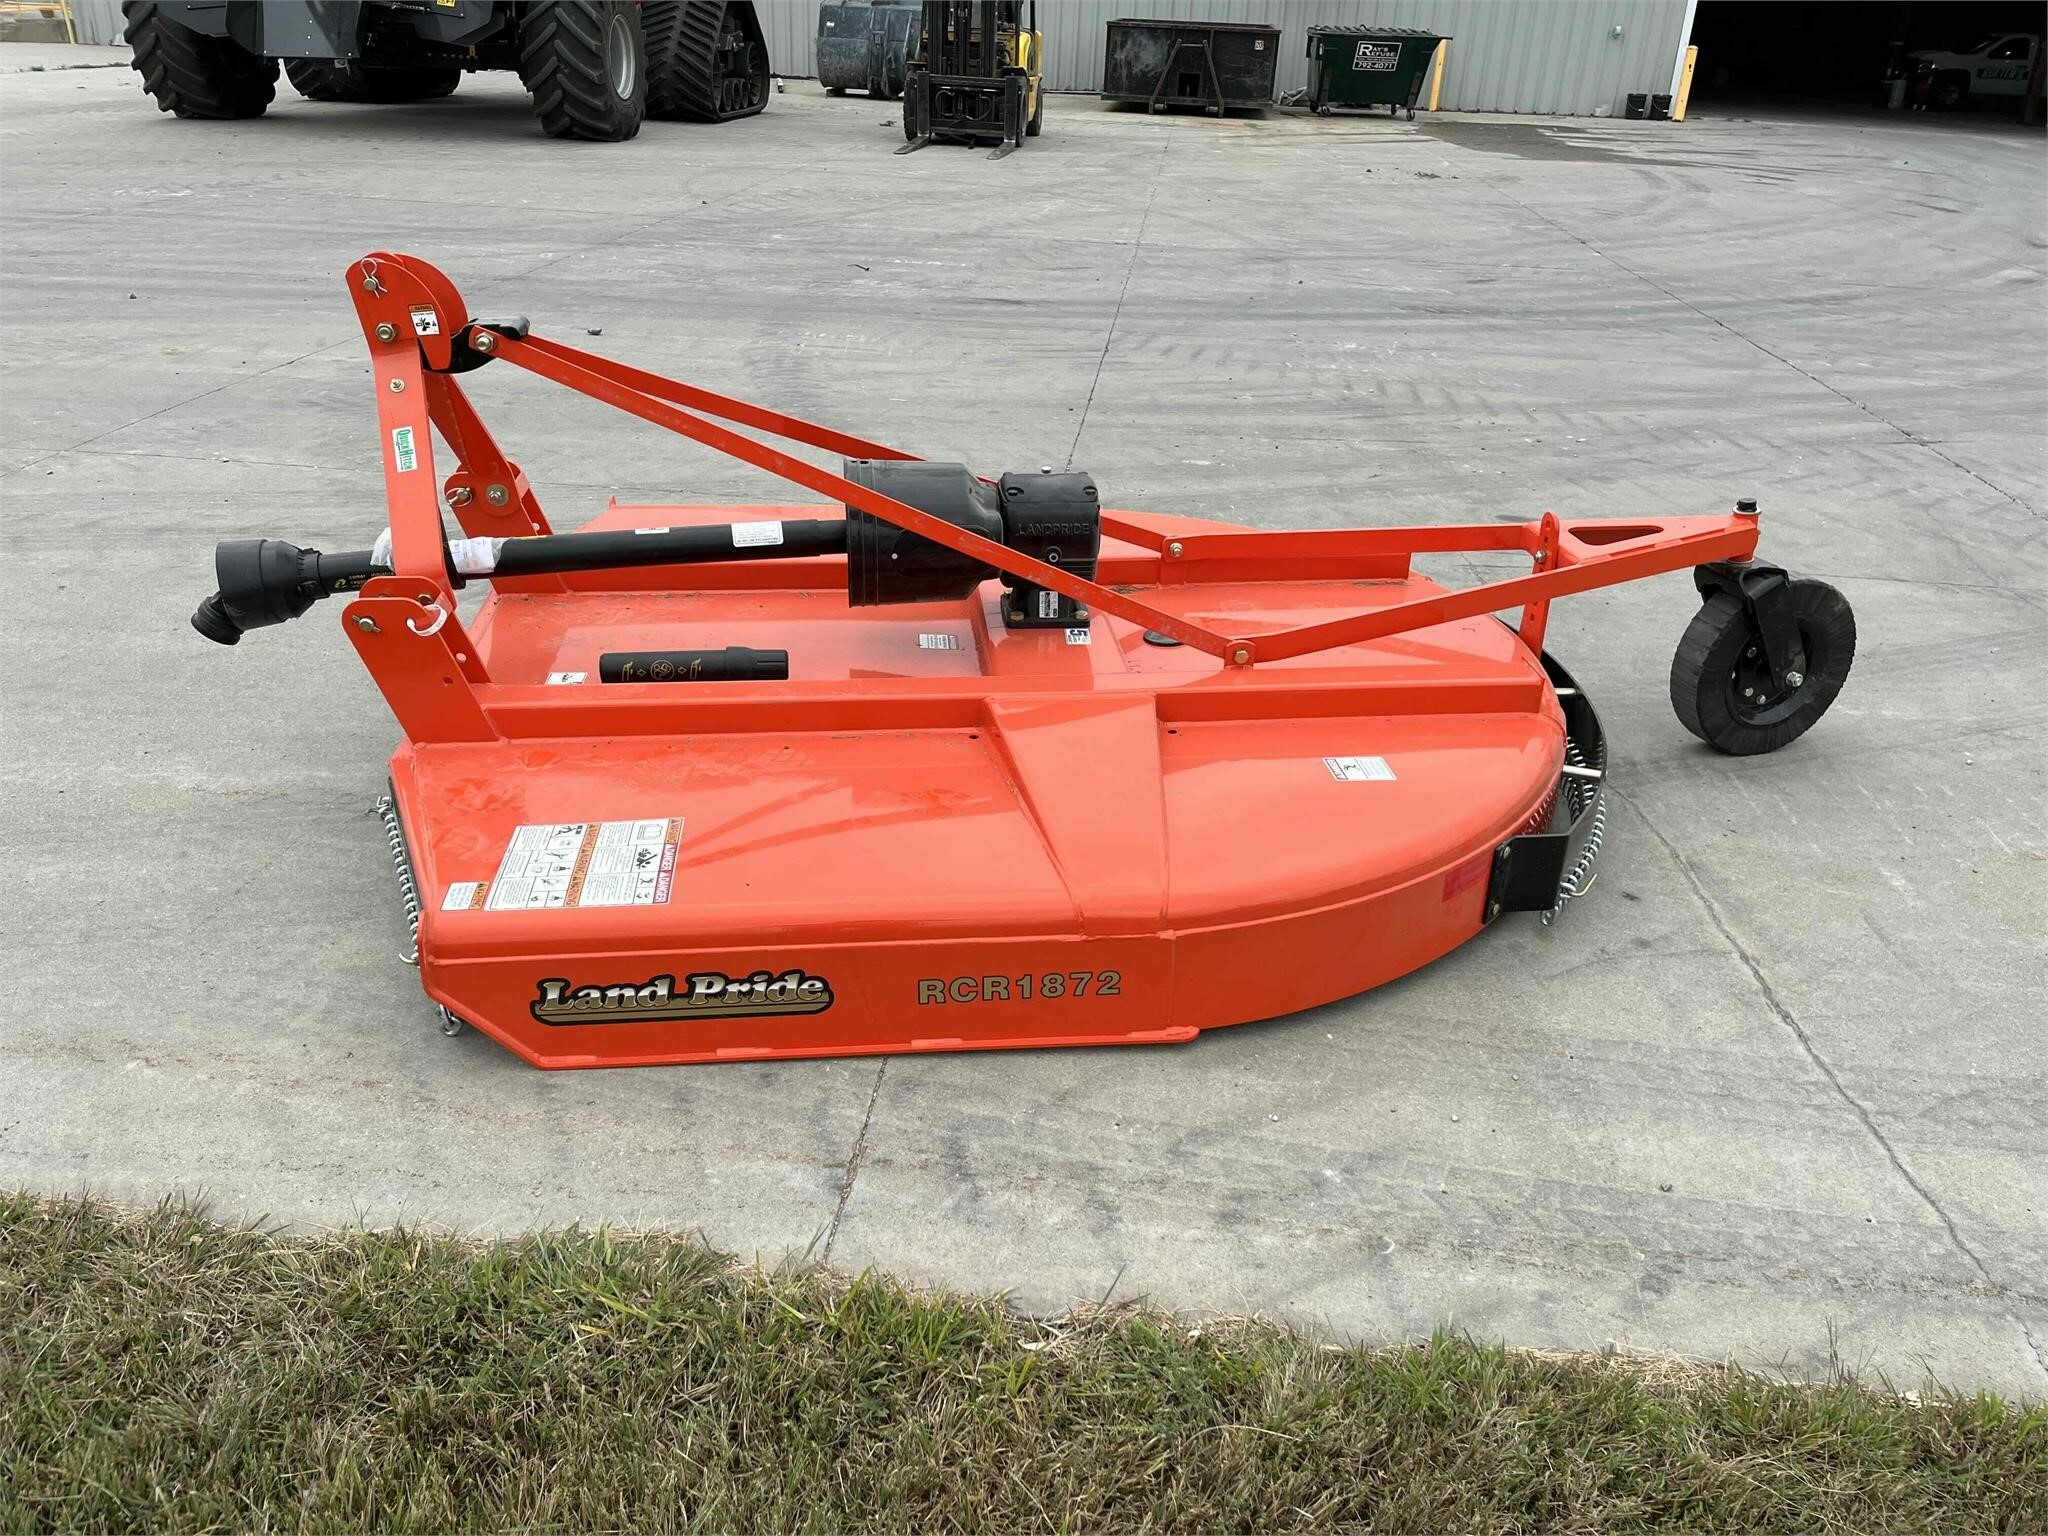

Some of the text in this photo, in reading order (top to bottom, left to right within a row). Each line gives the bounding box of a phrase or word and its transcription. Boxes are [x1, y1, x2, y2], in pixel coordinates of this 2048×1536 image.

[1018, 523, 1089, 536] LANDPRIDE
[661, 847, 676, 870] DANGER
[654, 876, 670, 901] DANGER
[540, 974, 824, 1011] Land Pride
[918, 970, 1121, 1005] RCR1872
